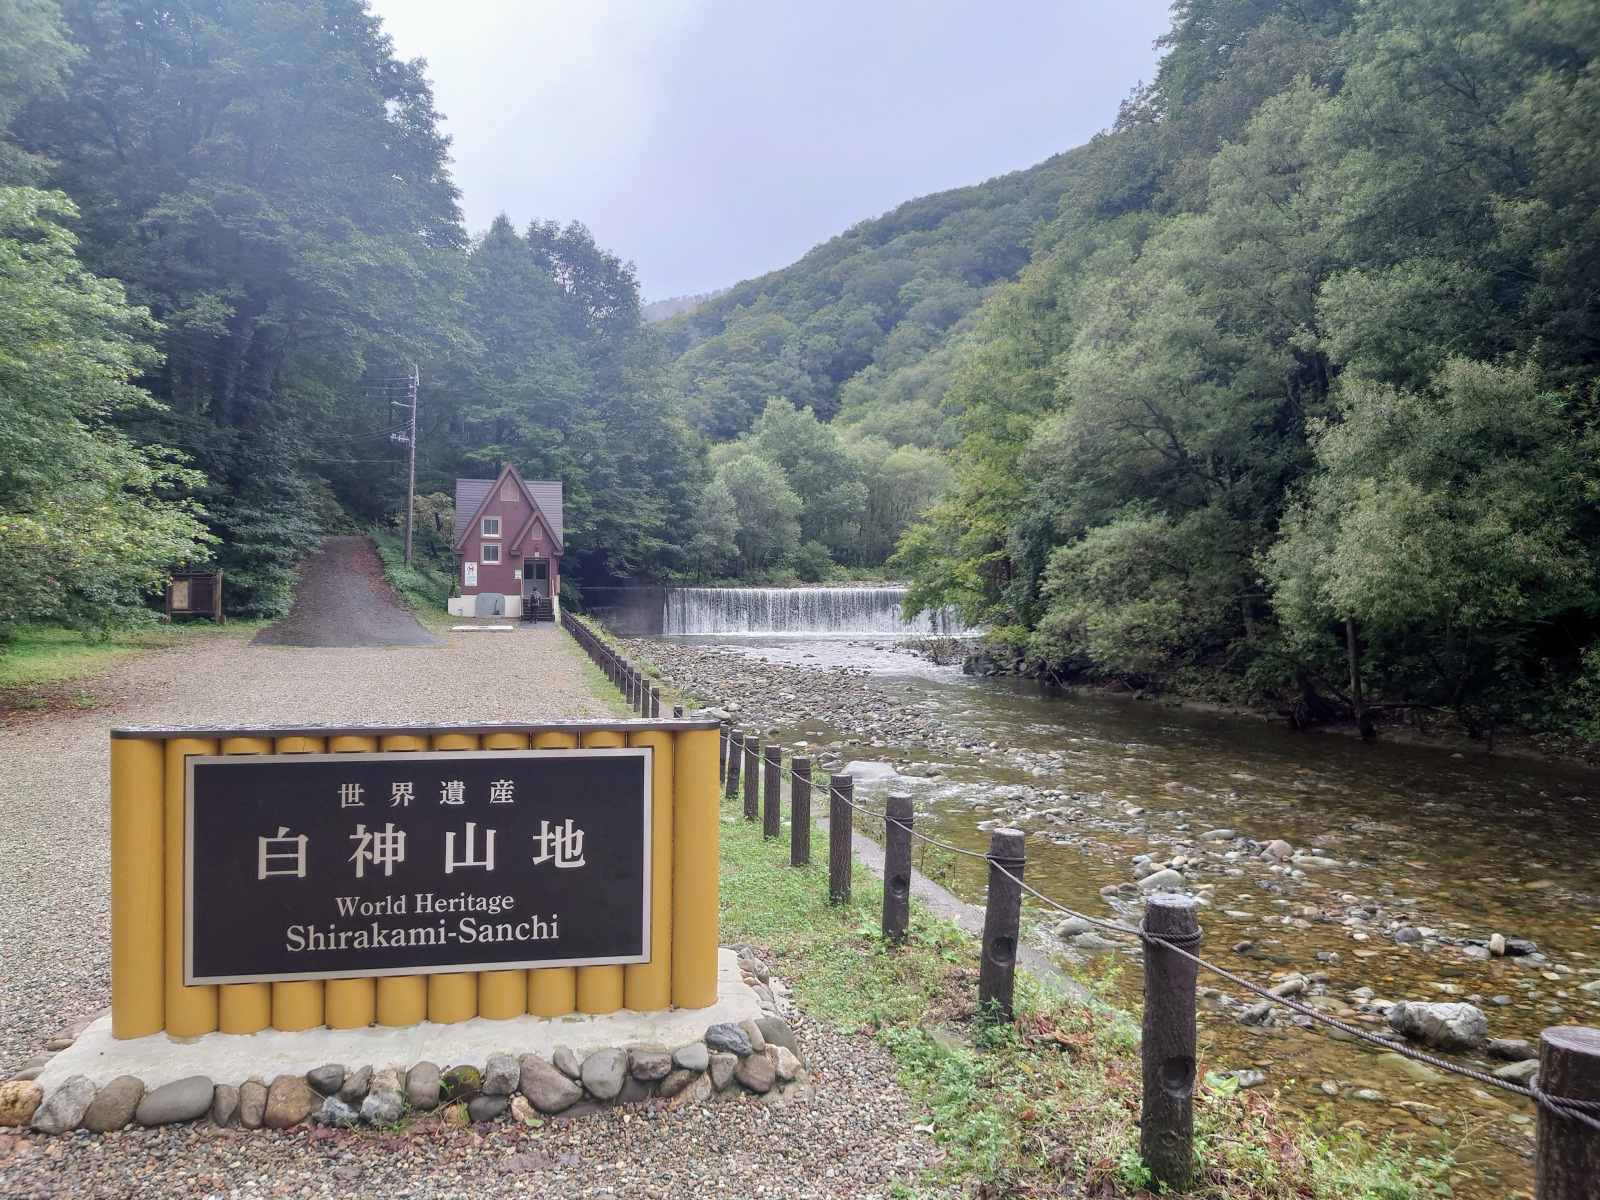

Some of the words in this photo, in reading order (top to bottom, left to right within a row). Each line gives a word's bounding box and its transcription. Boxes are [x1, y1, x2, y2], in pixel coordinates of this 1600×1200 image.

[337, 779, 515, 808] 世界遺産
[257, 818, 586, 880] 白神山地
[335, 894, 407, 917] World
[414, 892, 515, 915] Heritage
[286, 913, 559, 951] Shirakami-Sanchi
